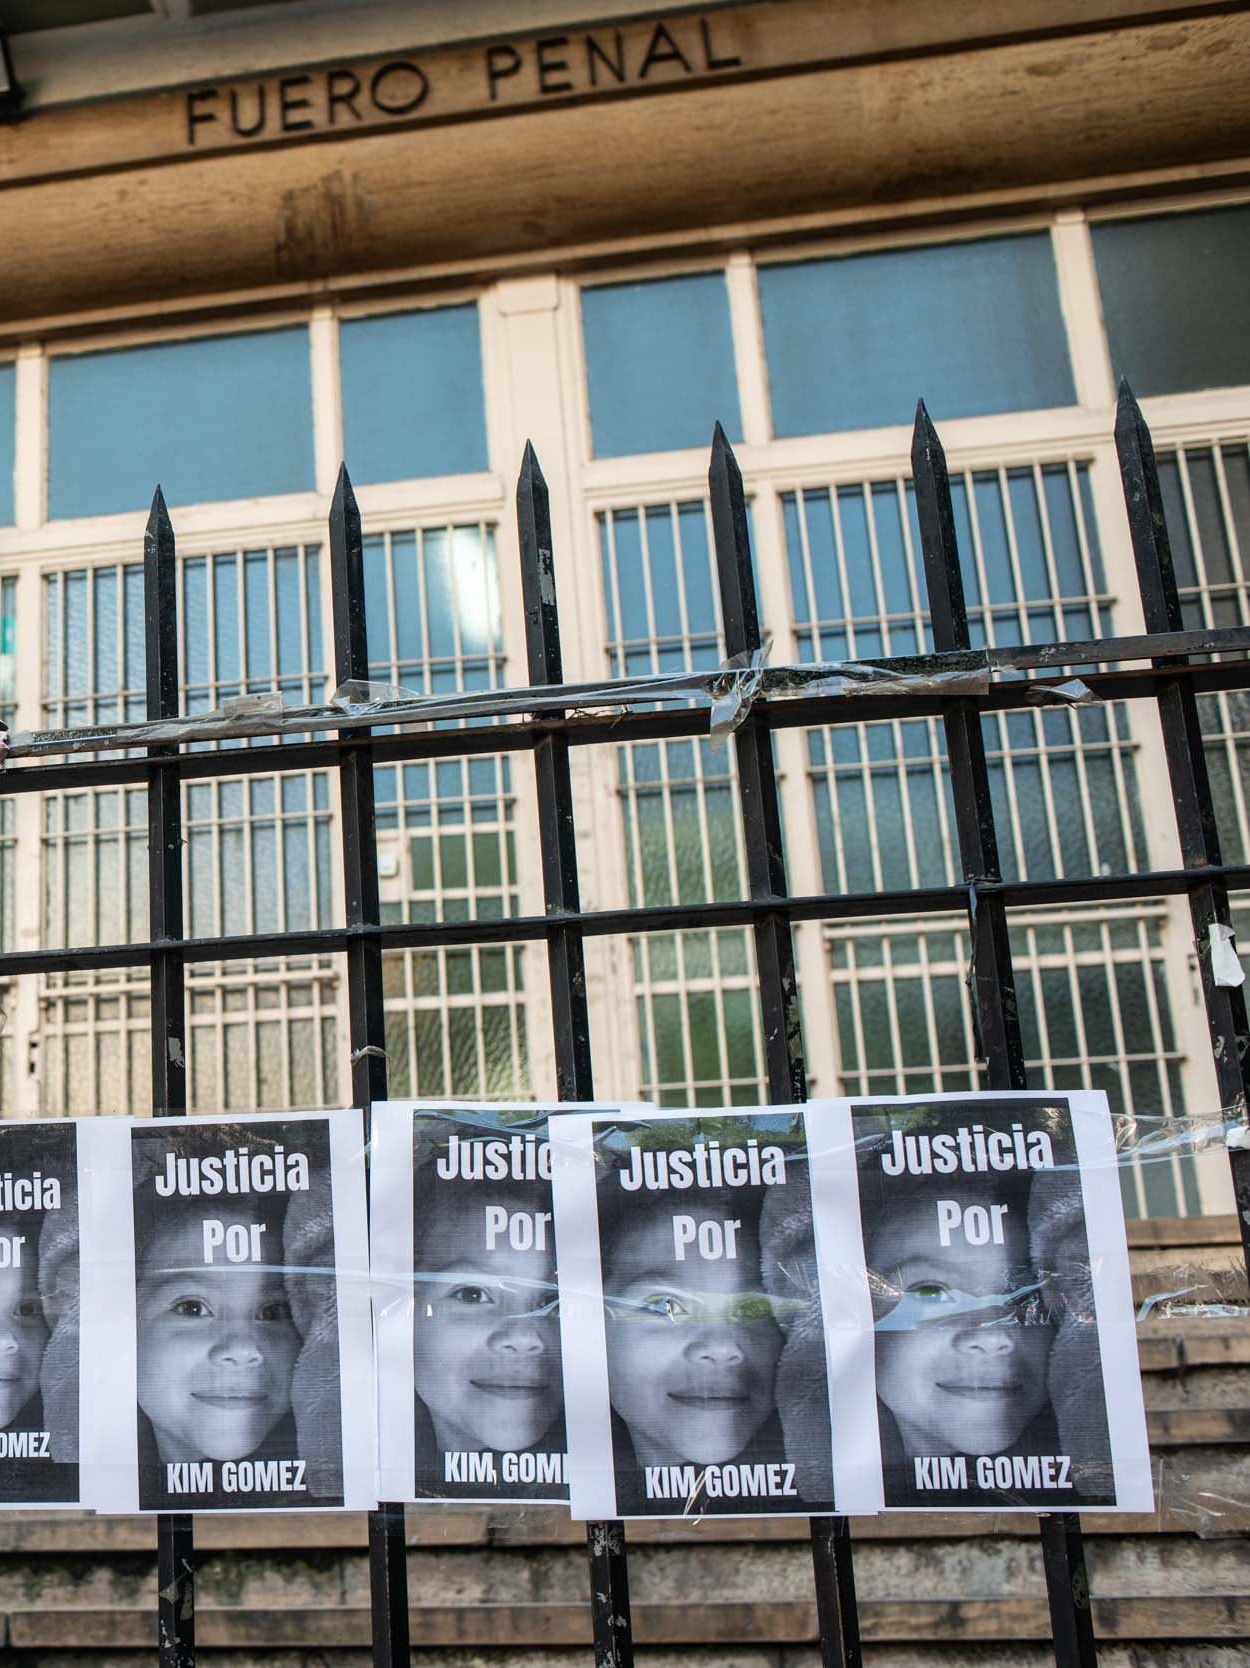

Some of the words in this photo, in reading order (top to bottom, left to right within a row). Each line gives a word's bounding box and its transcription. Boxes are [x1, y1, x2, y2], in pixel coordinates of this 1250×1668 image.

[185, 61, 430, 144] FUERO
[485, 19, 742, 100] PENAL
[155, 1145, 310, 1196] Justicia
[620, 1140, 786, 1191] Justicia
[881, 1123, 1054, 1176] Justicia
[202, 1219, 266, 1263] Por
[485, 1205, 552, 1251] Por
[672, 1215, 741, 1260] Por
[937, 1200, 1008, 1247] Por
[167, 1462, 213, 1492] KIM
[222, 1460, 306, 1492] GOMEZ
[445, 1451, 496, 1482] KIM
[645, 1465, 698, 1498] KIM
[705, 1463, 797, 1497] GOMEZ
[914, 1456, 968, 1490] KIM
[977, 1456, 1073, 1489] GOMEZ
